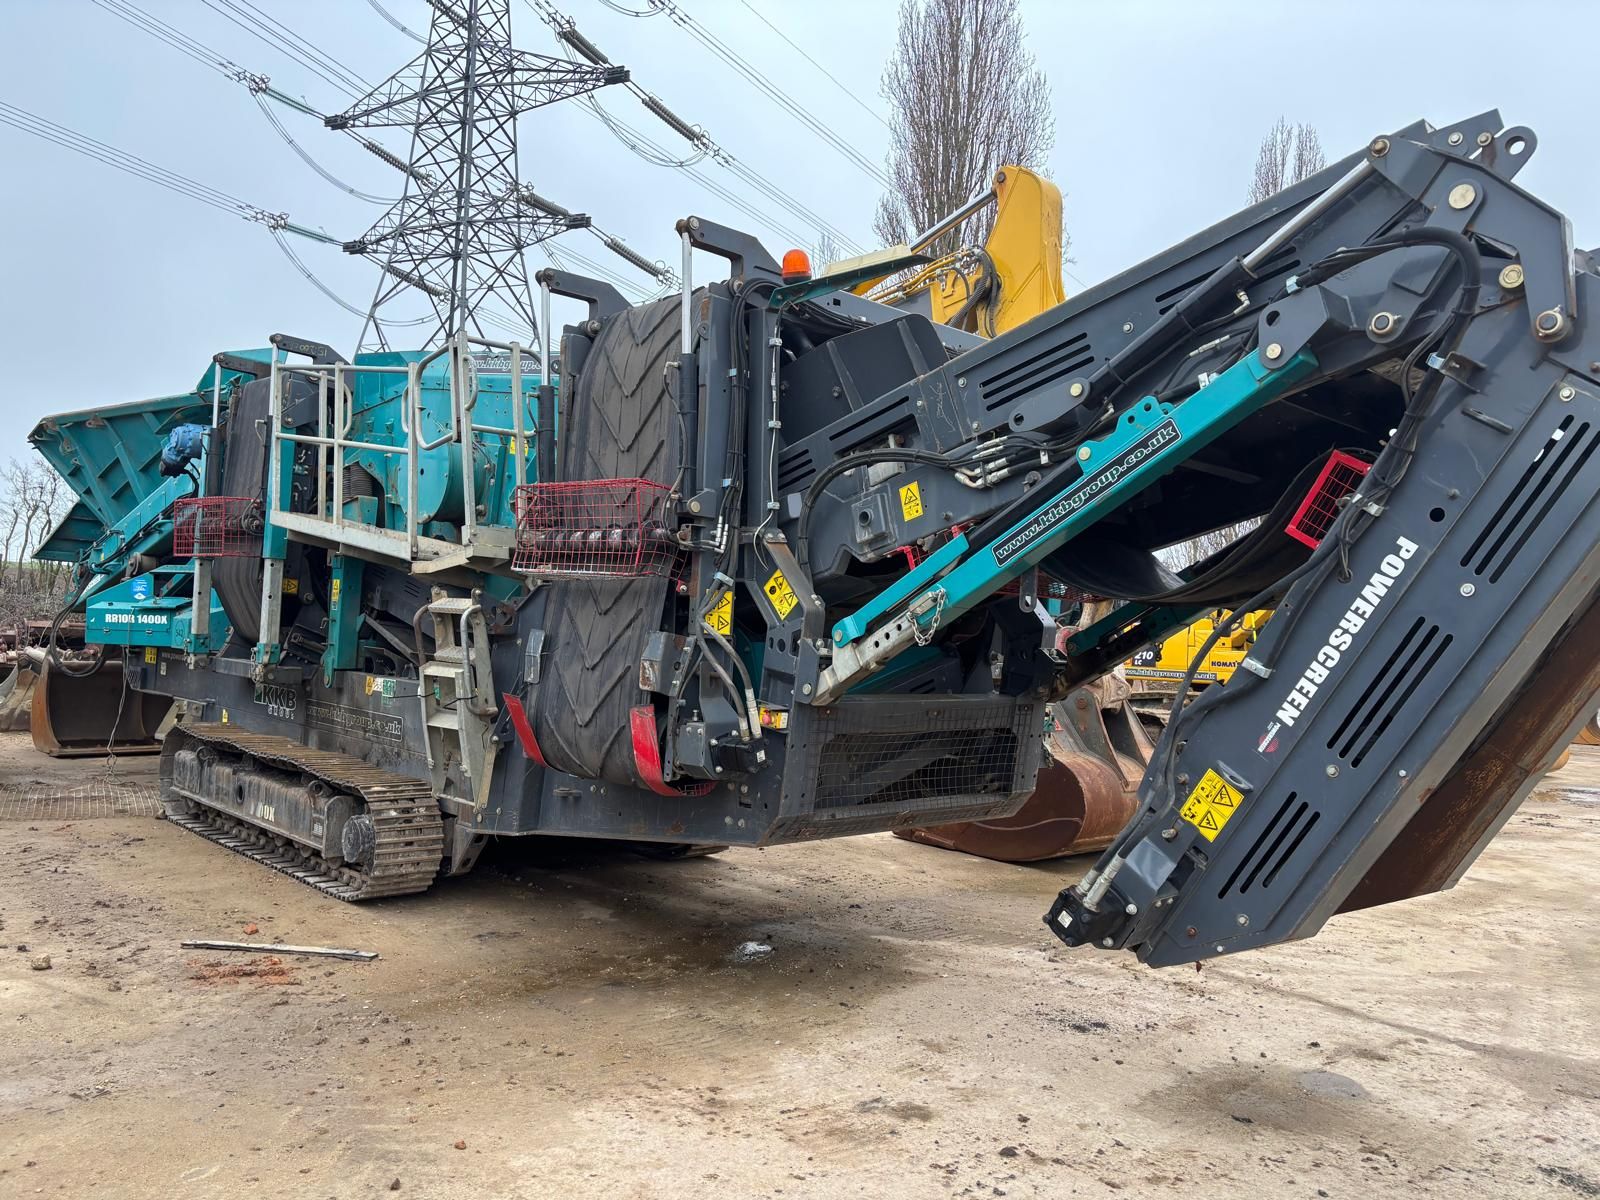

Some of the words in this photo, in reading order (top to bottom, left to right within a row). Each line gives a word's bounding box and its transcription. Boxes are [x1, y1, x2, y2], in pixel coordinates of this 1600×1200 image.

[996, 425, 1176, 558] www.kkbgroup.co.uk
[136, 614, 168, 625] 1400X
[1275, 536, 1420, 727] POWERSCREEN
[1211, 660, 1241, 668] KOMAT
[261, 683, 297, 711] KKB
